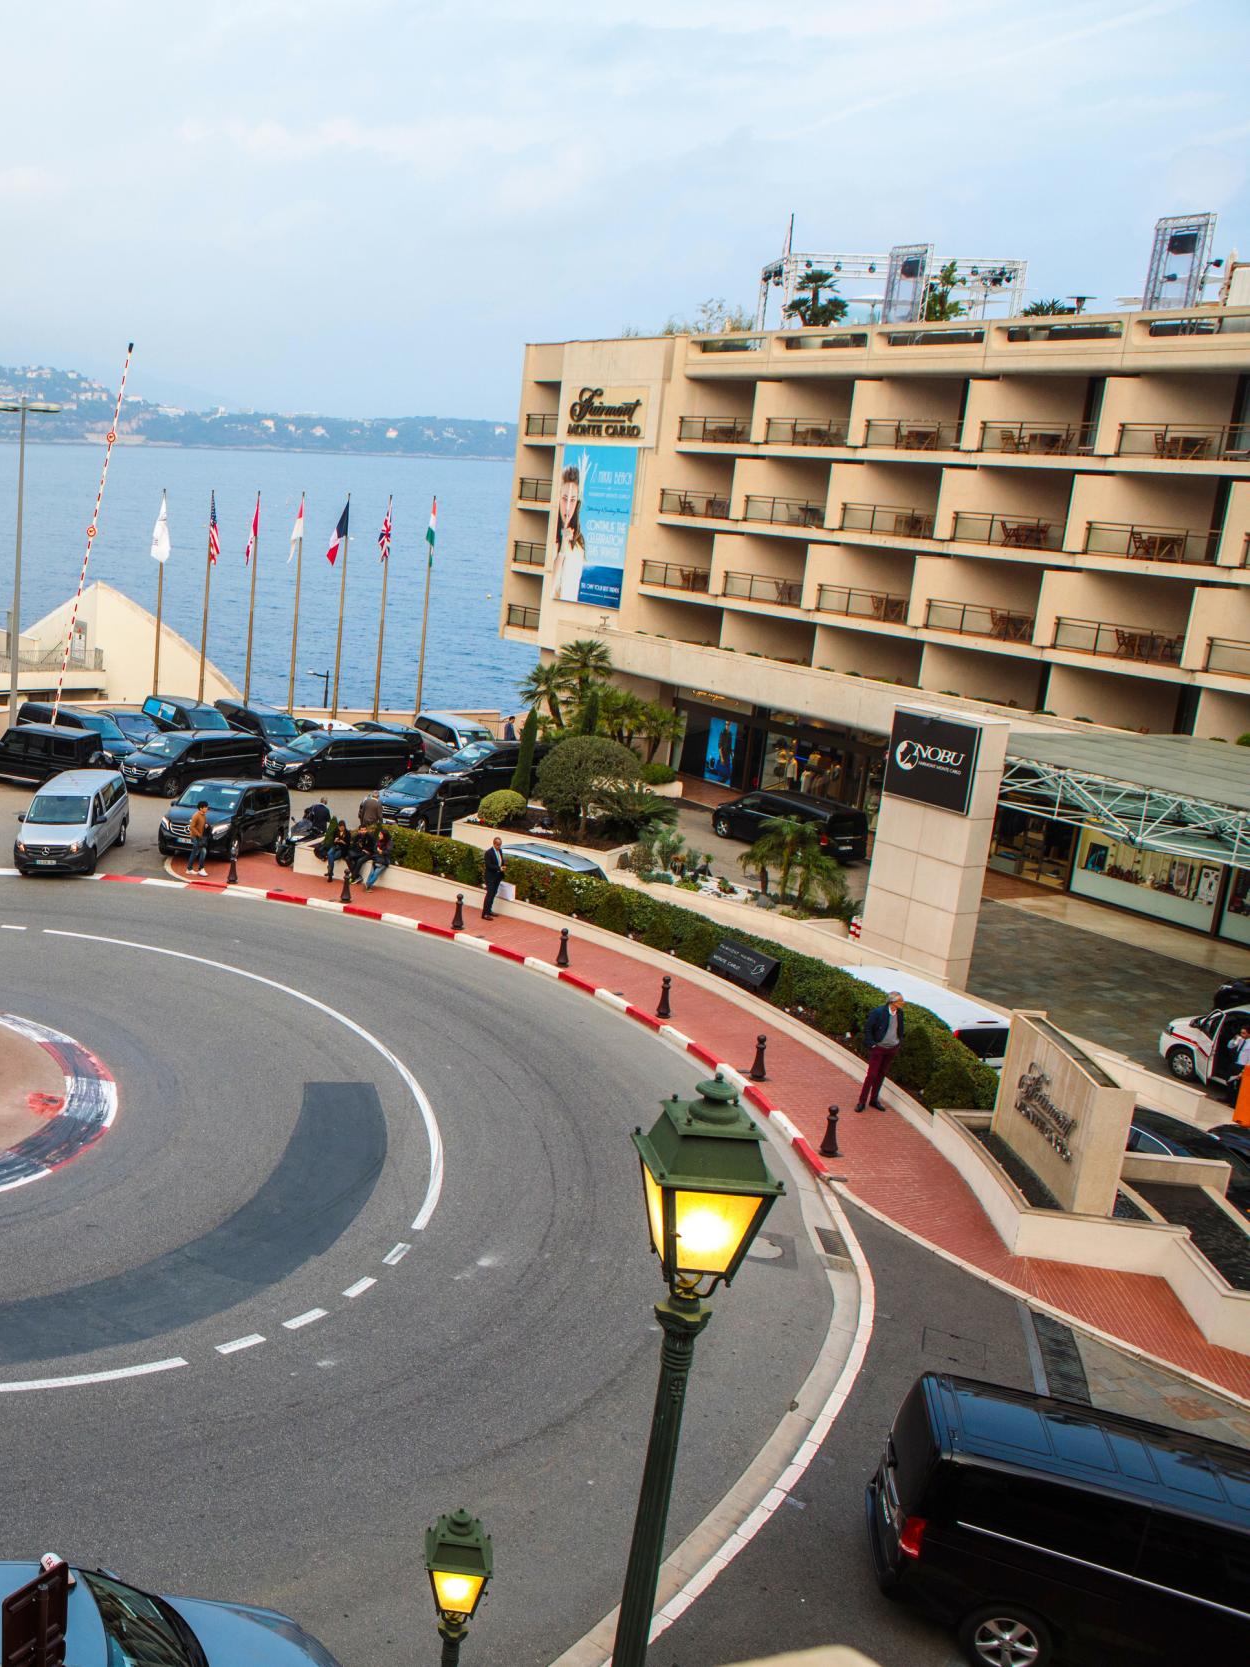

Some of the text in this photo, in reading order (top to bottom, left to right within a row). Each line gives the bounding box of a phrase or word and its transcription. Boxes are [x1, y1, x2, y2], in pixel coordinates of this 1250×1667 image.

[570, 387, 642, 423] Fairmont
[567, 424, 641, 437] MONTE CARLO
[913, 743, 966, 766] NOBU
